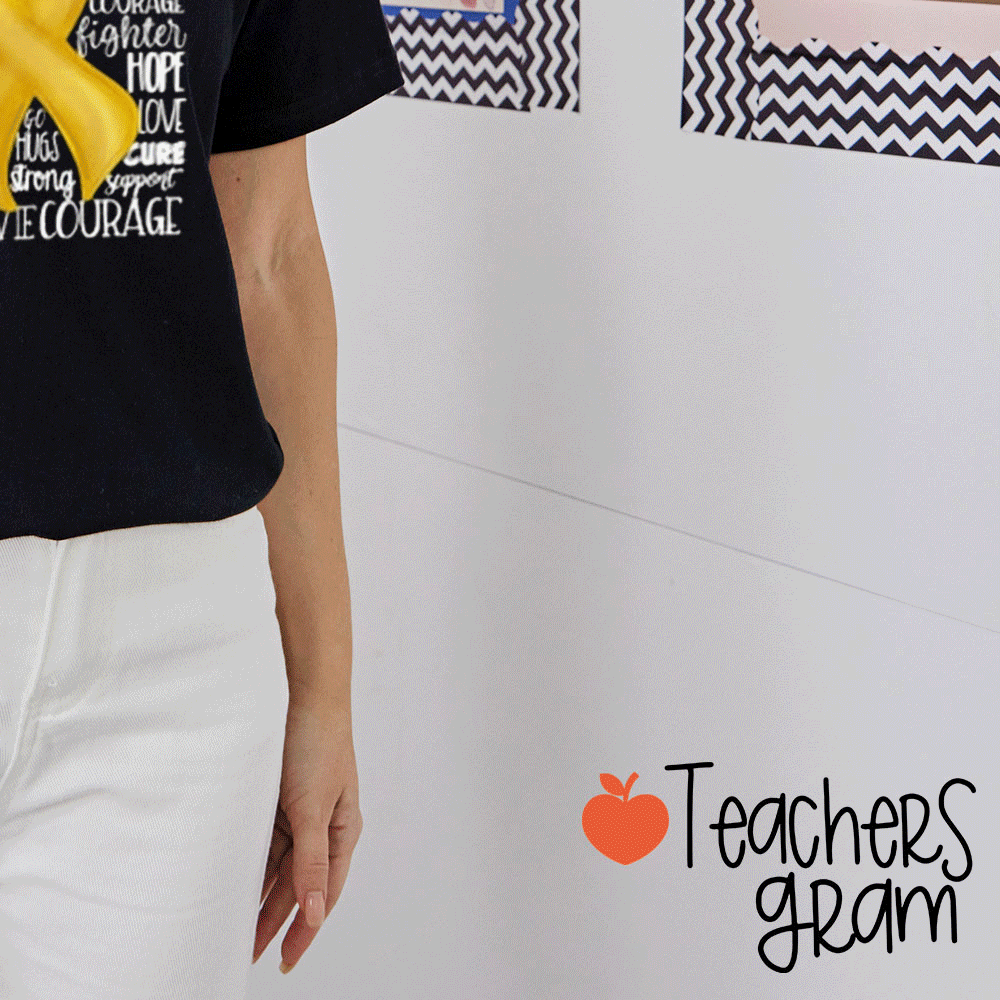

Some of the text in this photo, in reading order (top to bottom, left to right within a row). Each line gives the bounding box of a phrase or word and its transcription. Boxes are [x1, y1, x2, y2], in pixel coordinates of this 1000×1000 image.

[76, 16, 187, 57] fighter
[126, 51, 186, 93] HOPE
[138, 97, 187, 134] LOVE
[16, 131, 60, 162] HUGS
[123, 140, 187, 167] CURE
[39, 196, 184, 239] COURAGE
